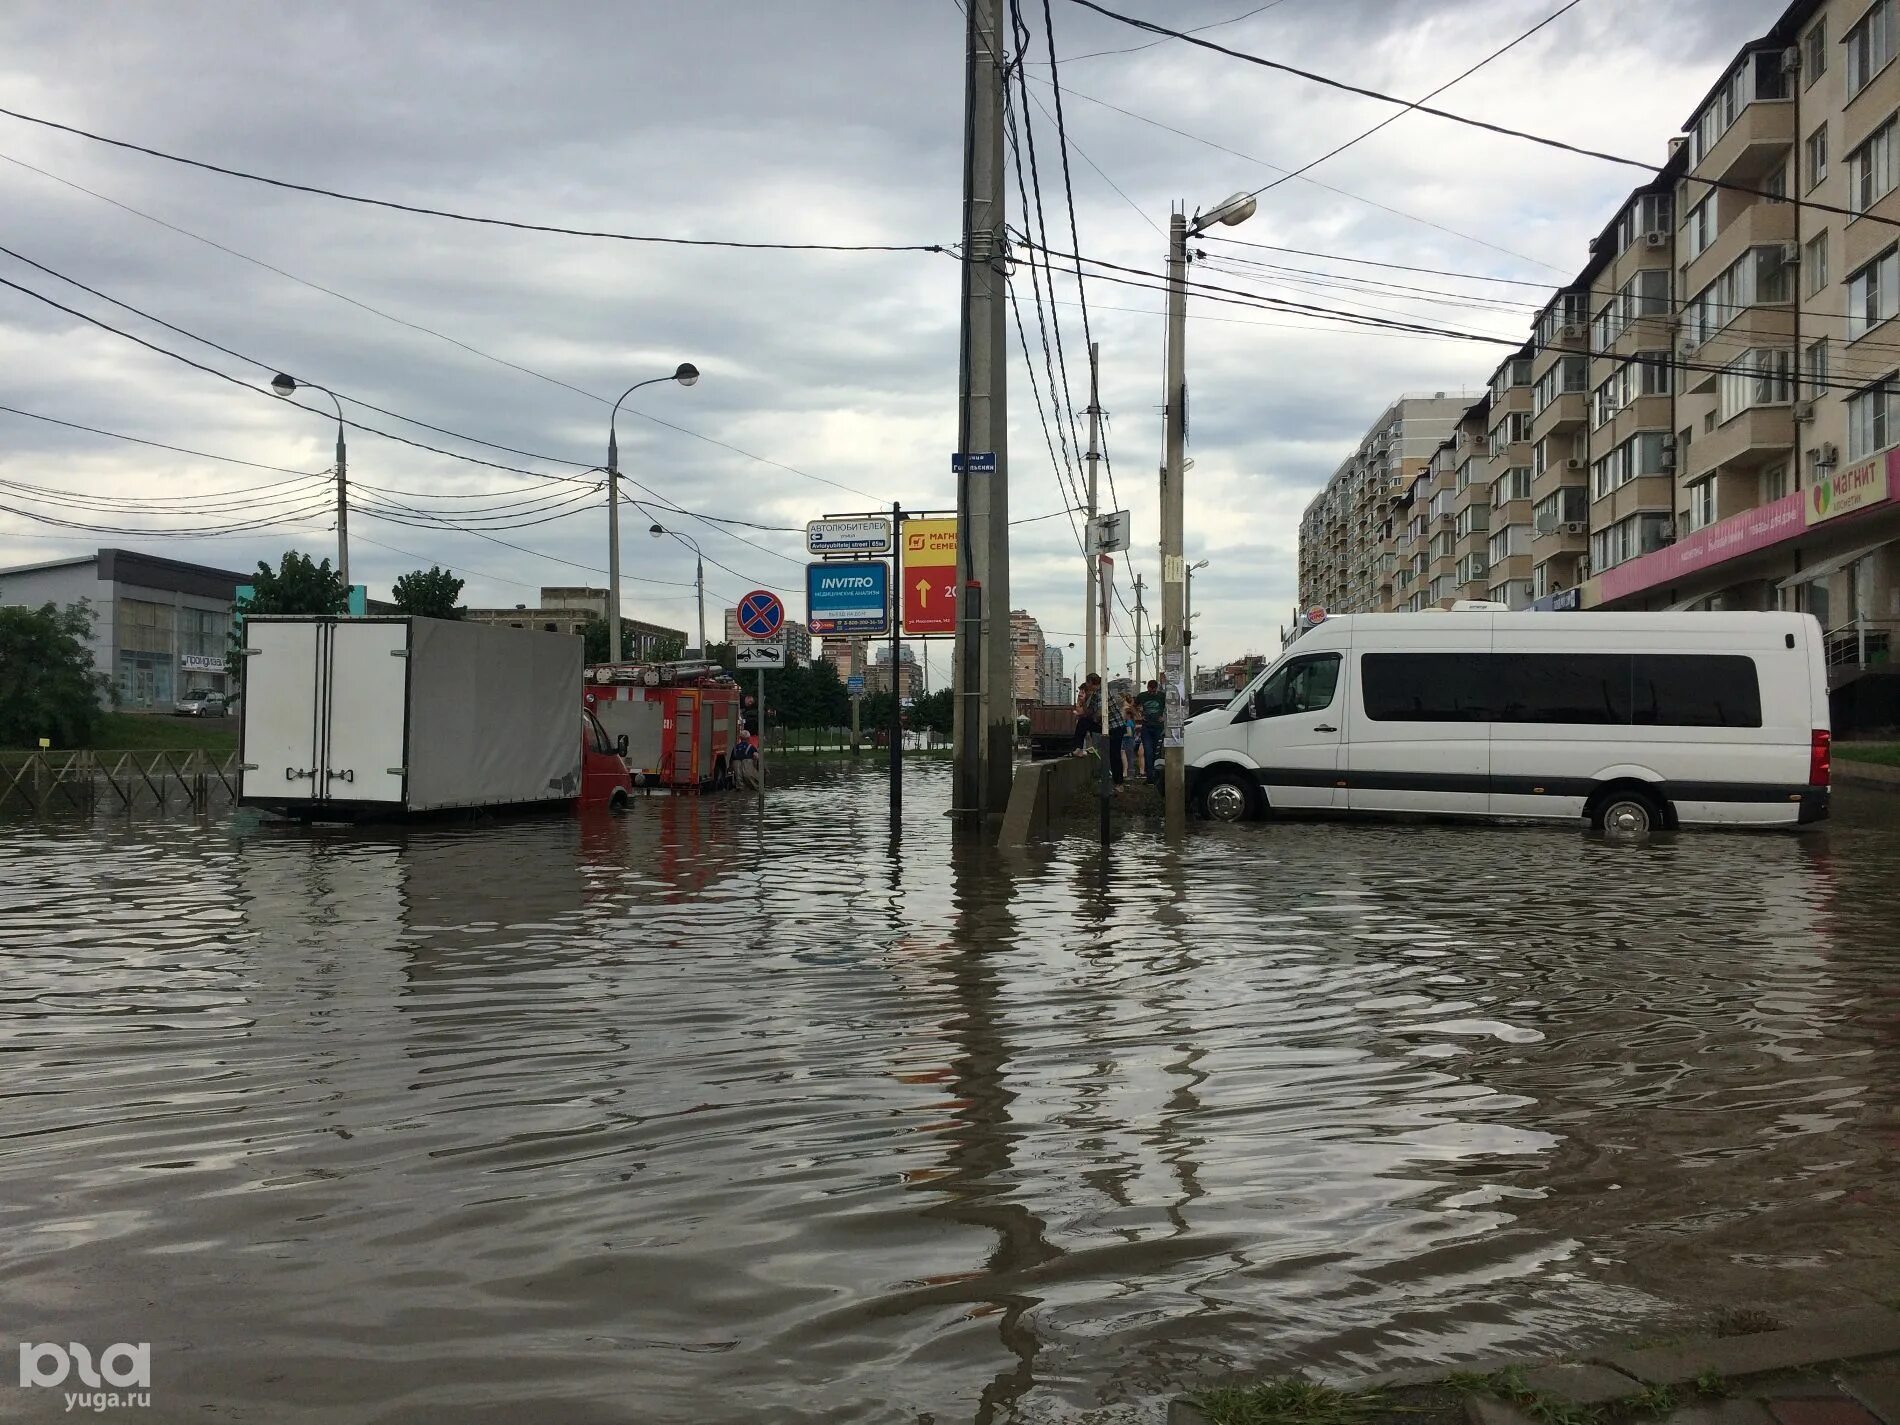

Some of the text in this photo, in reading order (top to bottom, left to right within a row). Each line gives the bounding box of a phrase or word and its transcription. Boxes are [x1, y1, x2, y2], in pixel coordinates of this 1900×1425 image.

[810, 521, 886, 532] АВТОЛЮБИТЕЛЕЙ
[851, 541, 868, 549] street
[821, 577, 873, 589] INVITRO
